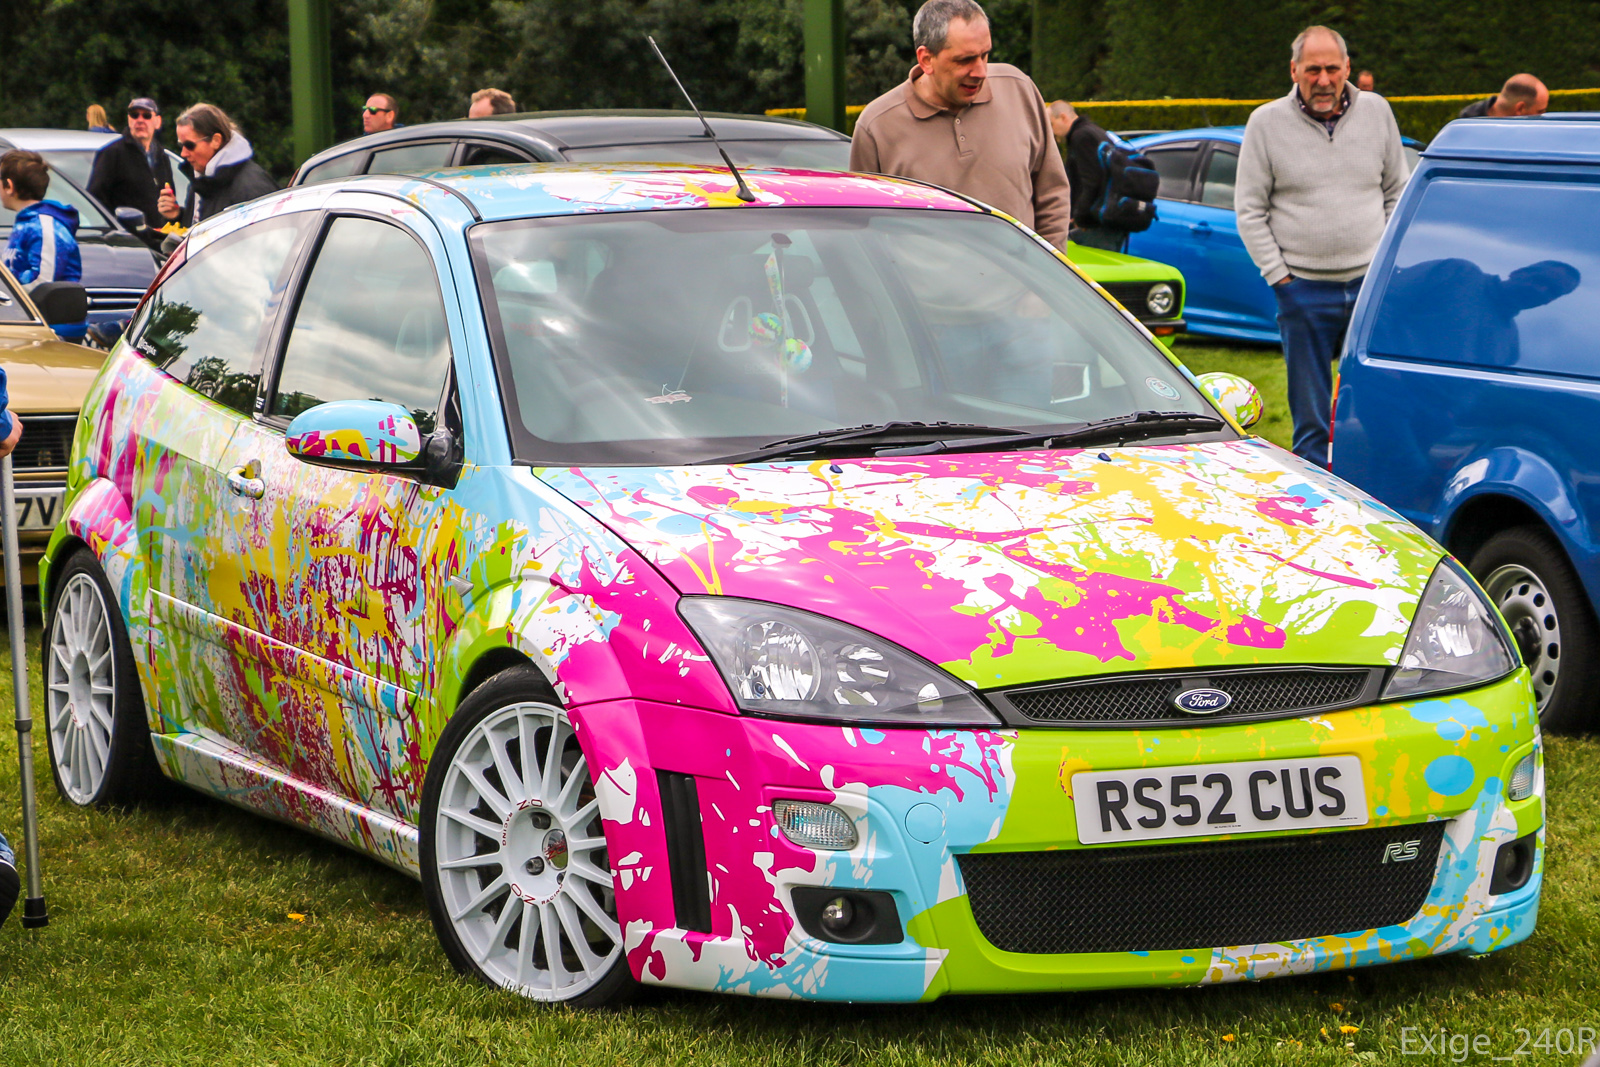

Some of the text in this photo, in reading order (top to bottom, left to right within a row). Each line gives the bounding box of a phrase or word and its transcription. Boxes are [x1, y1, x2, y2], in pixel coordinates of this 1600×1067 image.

[15, 496, 57, 527] 7V
[1189, 693, 1219, 707] Ford
[1096, 766, 1346, 833] RS52 CUS
[1382, 839, 1421, 864] RS
